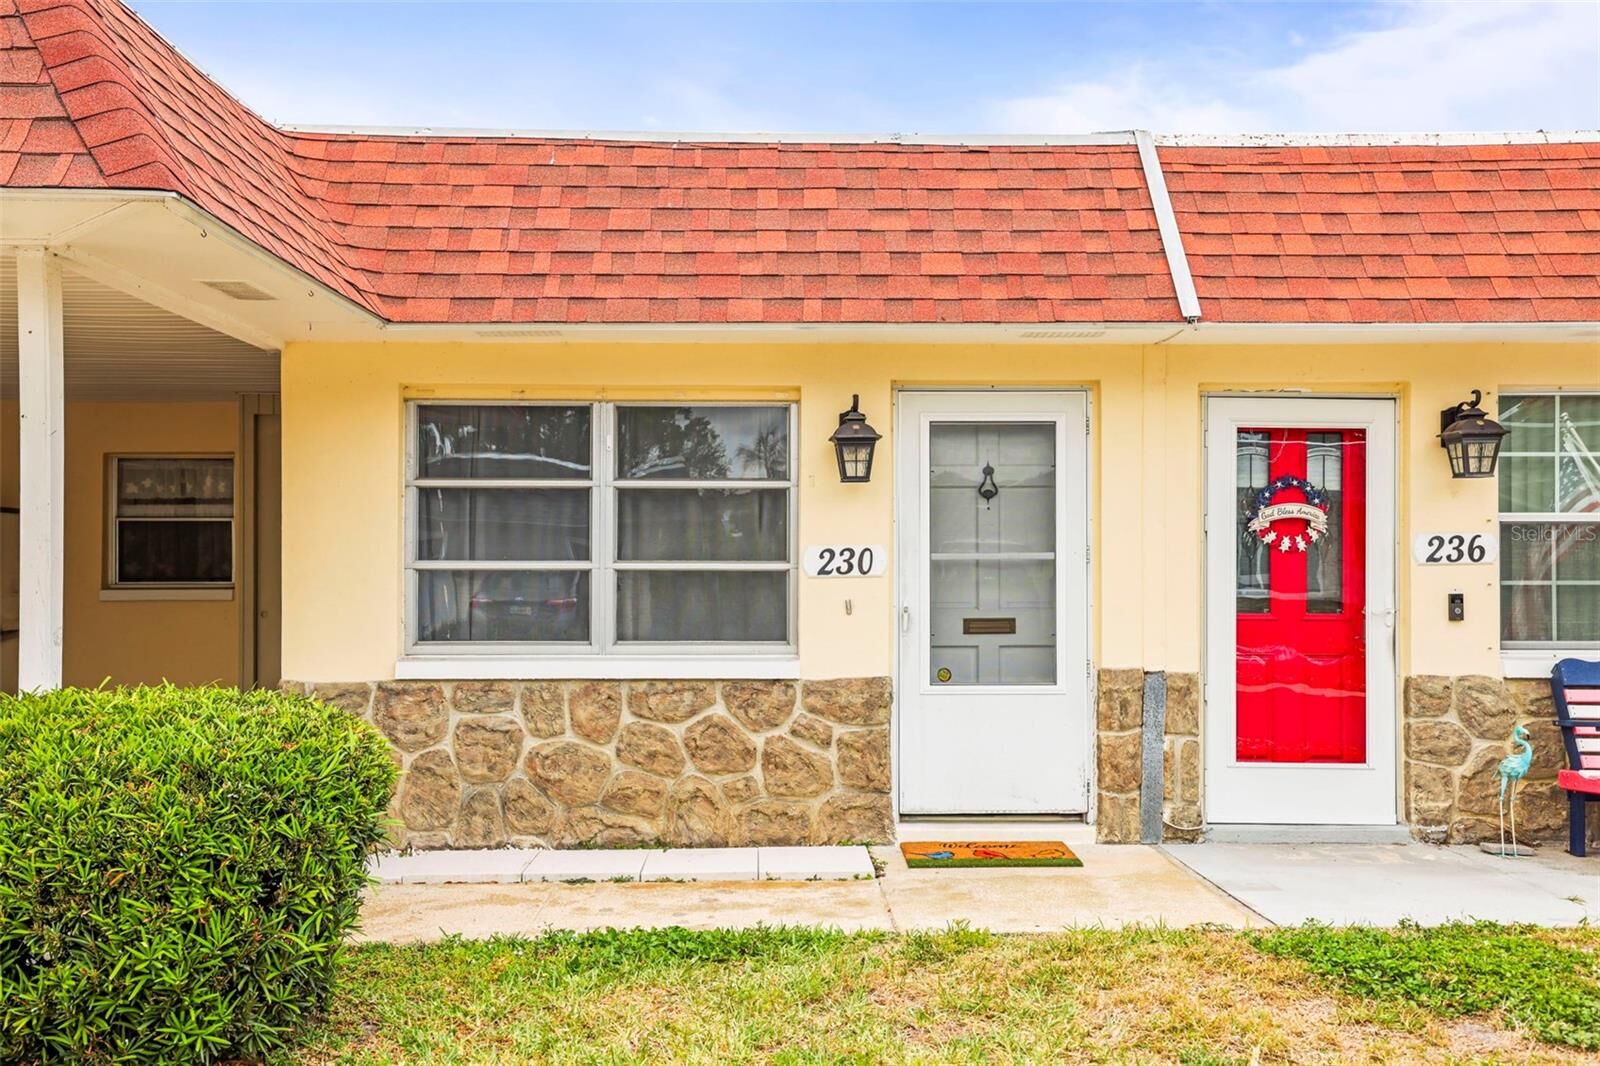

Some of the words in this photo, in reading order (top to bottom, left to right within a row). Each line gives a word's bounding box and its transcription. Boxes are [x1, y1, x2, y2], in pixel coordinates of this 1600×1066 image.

[1260, 509, 1275, 520] God
[1277, 506, 1295, 516] Bless
[1296, 507, 1320, 519] America
[816, 547, 874, 576] 230
[1425, 534, 1486, 563] 236
